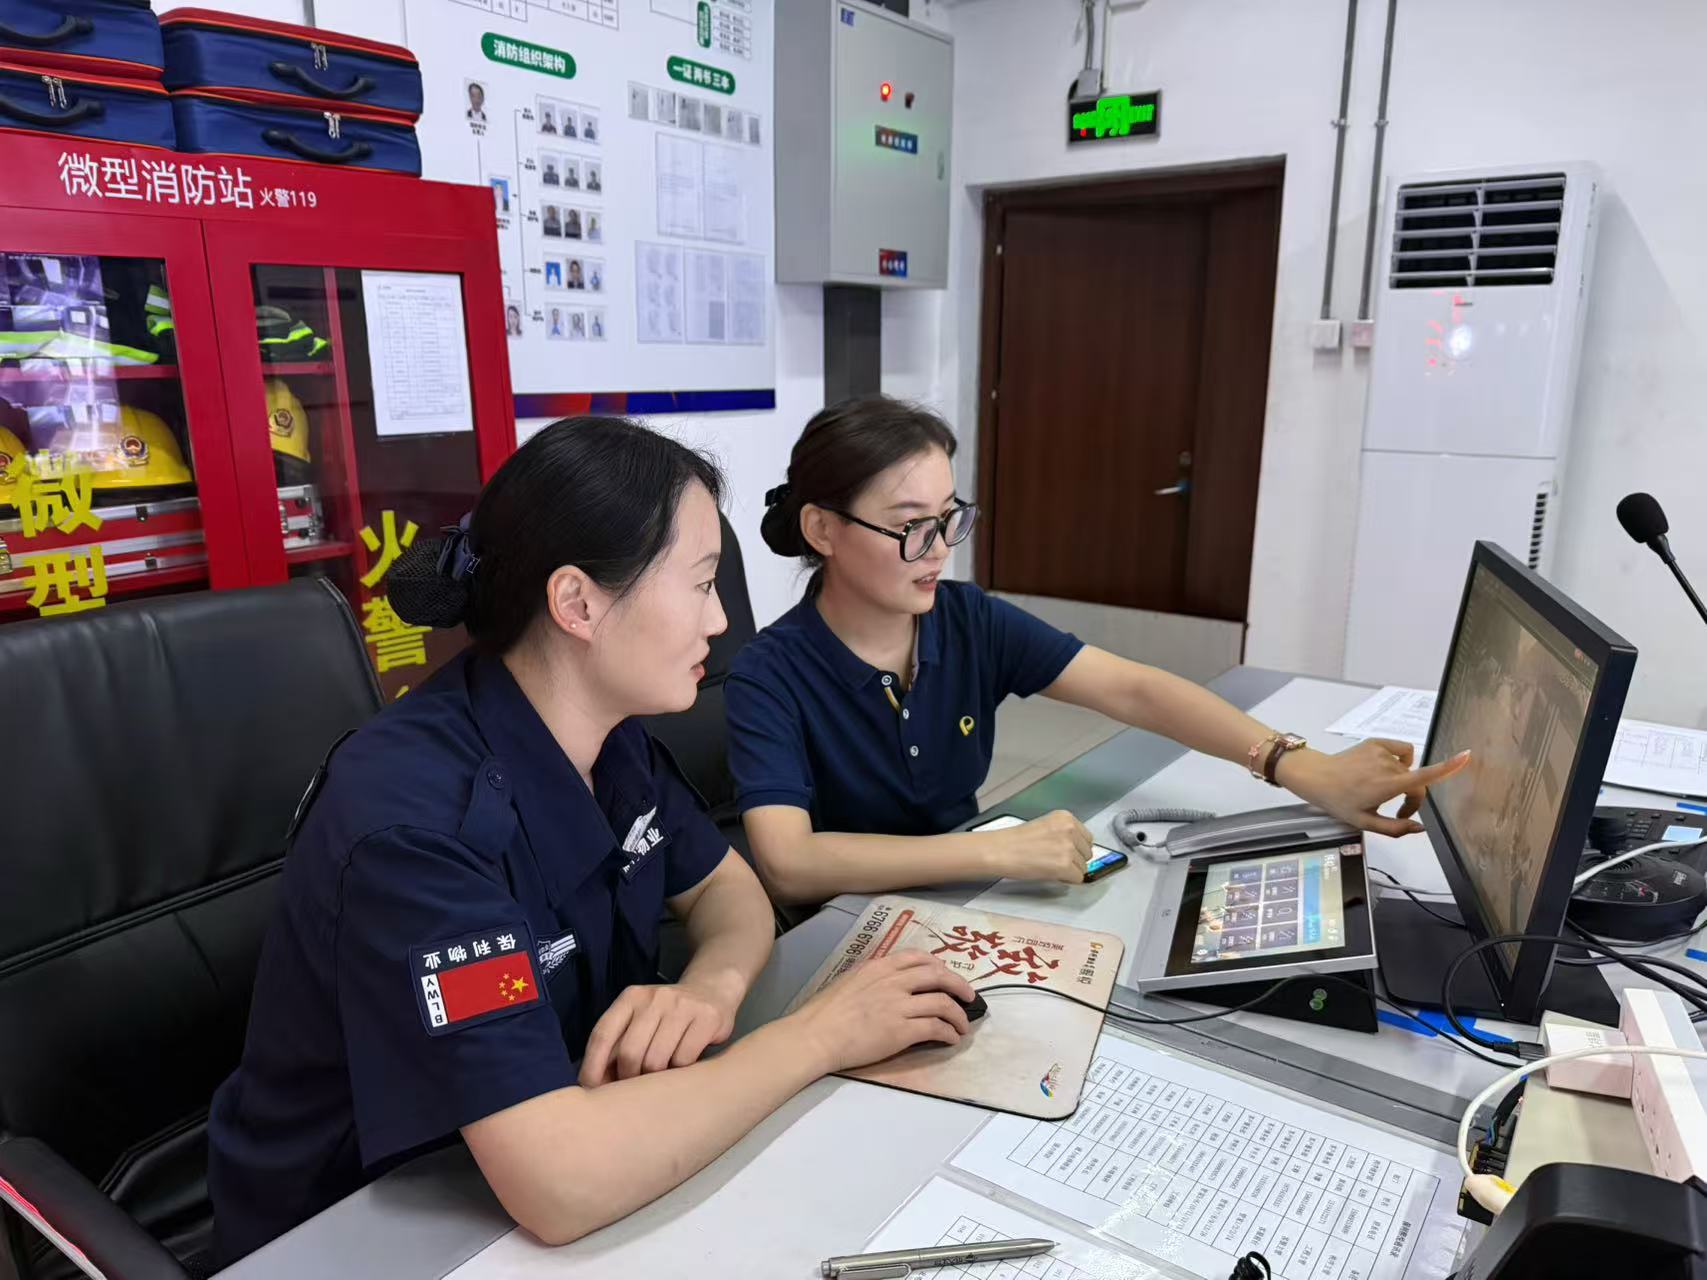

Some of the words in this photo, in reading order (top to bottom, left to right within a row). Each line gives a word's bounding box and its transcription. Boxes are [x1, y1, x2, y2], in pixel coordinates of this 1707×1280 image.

[493, 39, 566, 74] 消防组织架构
[57, 151, 254, 209] 微型消防站
[259, 187, 317, 208] 火警119
[11, 449, 108, 617] 微型
[360, 510, 432, 699] 火警
[862, 910, 889, 933] 6766
[423, 933, 517, 970] 保利物业
[844, 931, 873, 956] 6766
[426, 977, 443, 1024] BLWY
